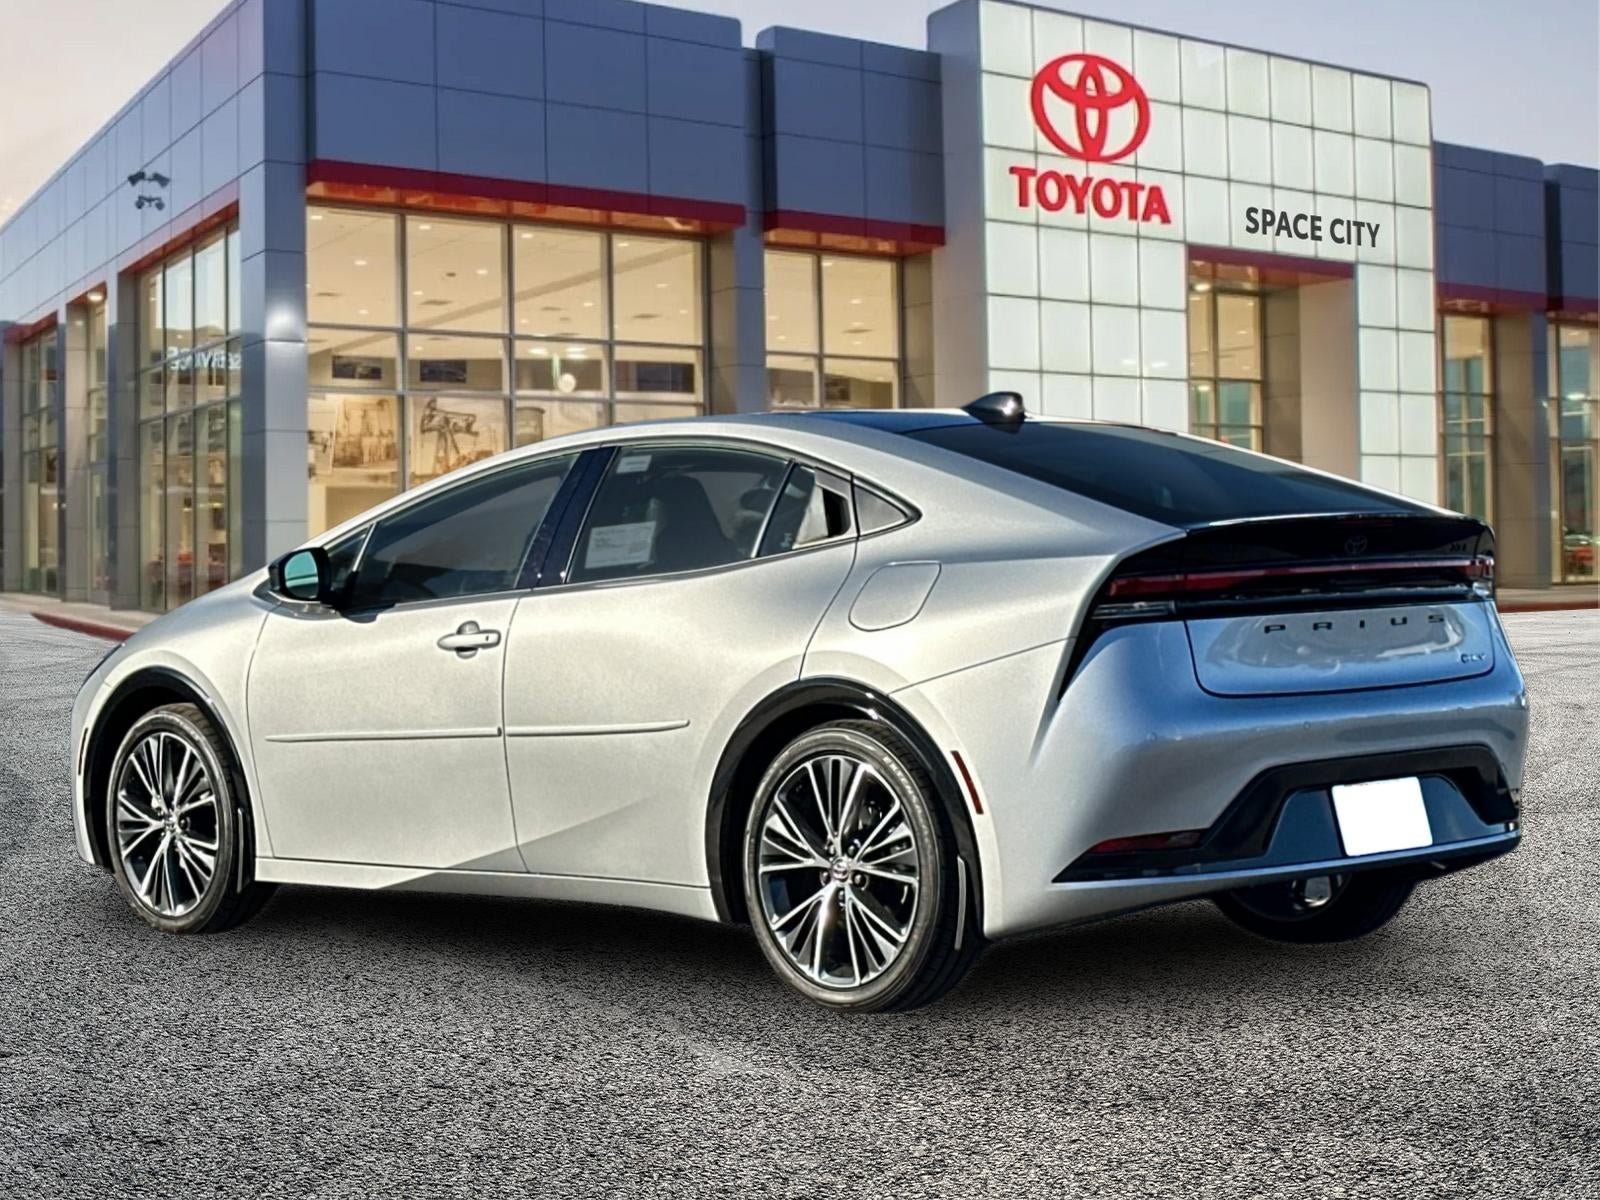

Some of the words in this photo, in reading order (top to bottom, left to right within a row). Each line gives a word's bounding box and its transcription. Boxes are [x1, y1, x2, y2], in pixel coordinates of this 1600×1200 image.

[1009, 166, 1171, 224] TOYOTA
[1245, 206, 1323, 242] SPACE
[1329, 218, 1381, 248] CITY
[1264, 614, 1445, 634] PRIUS
